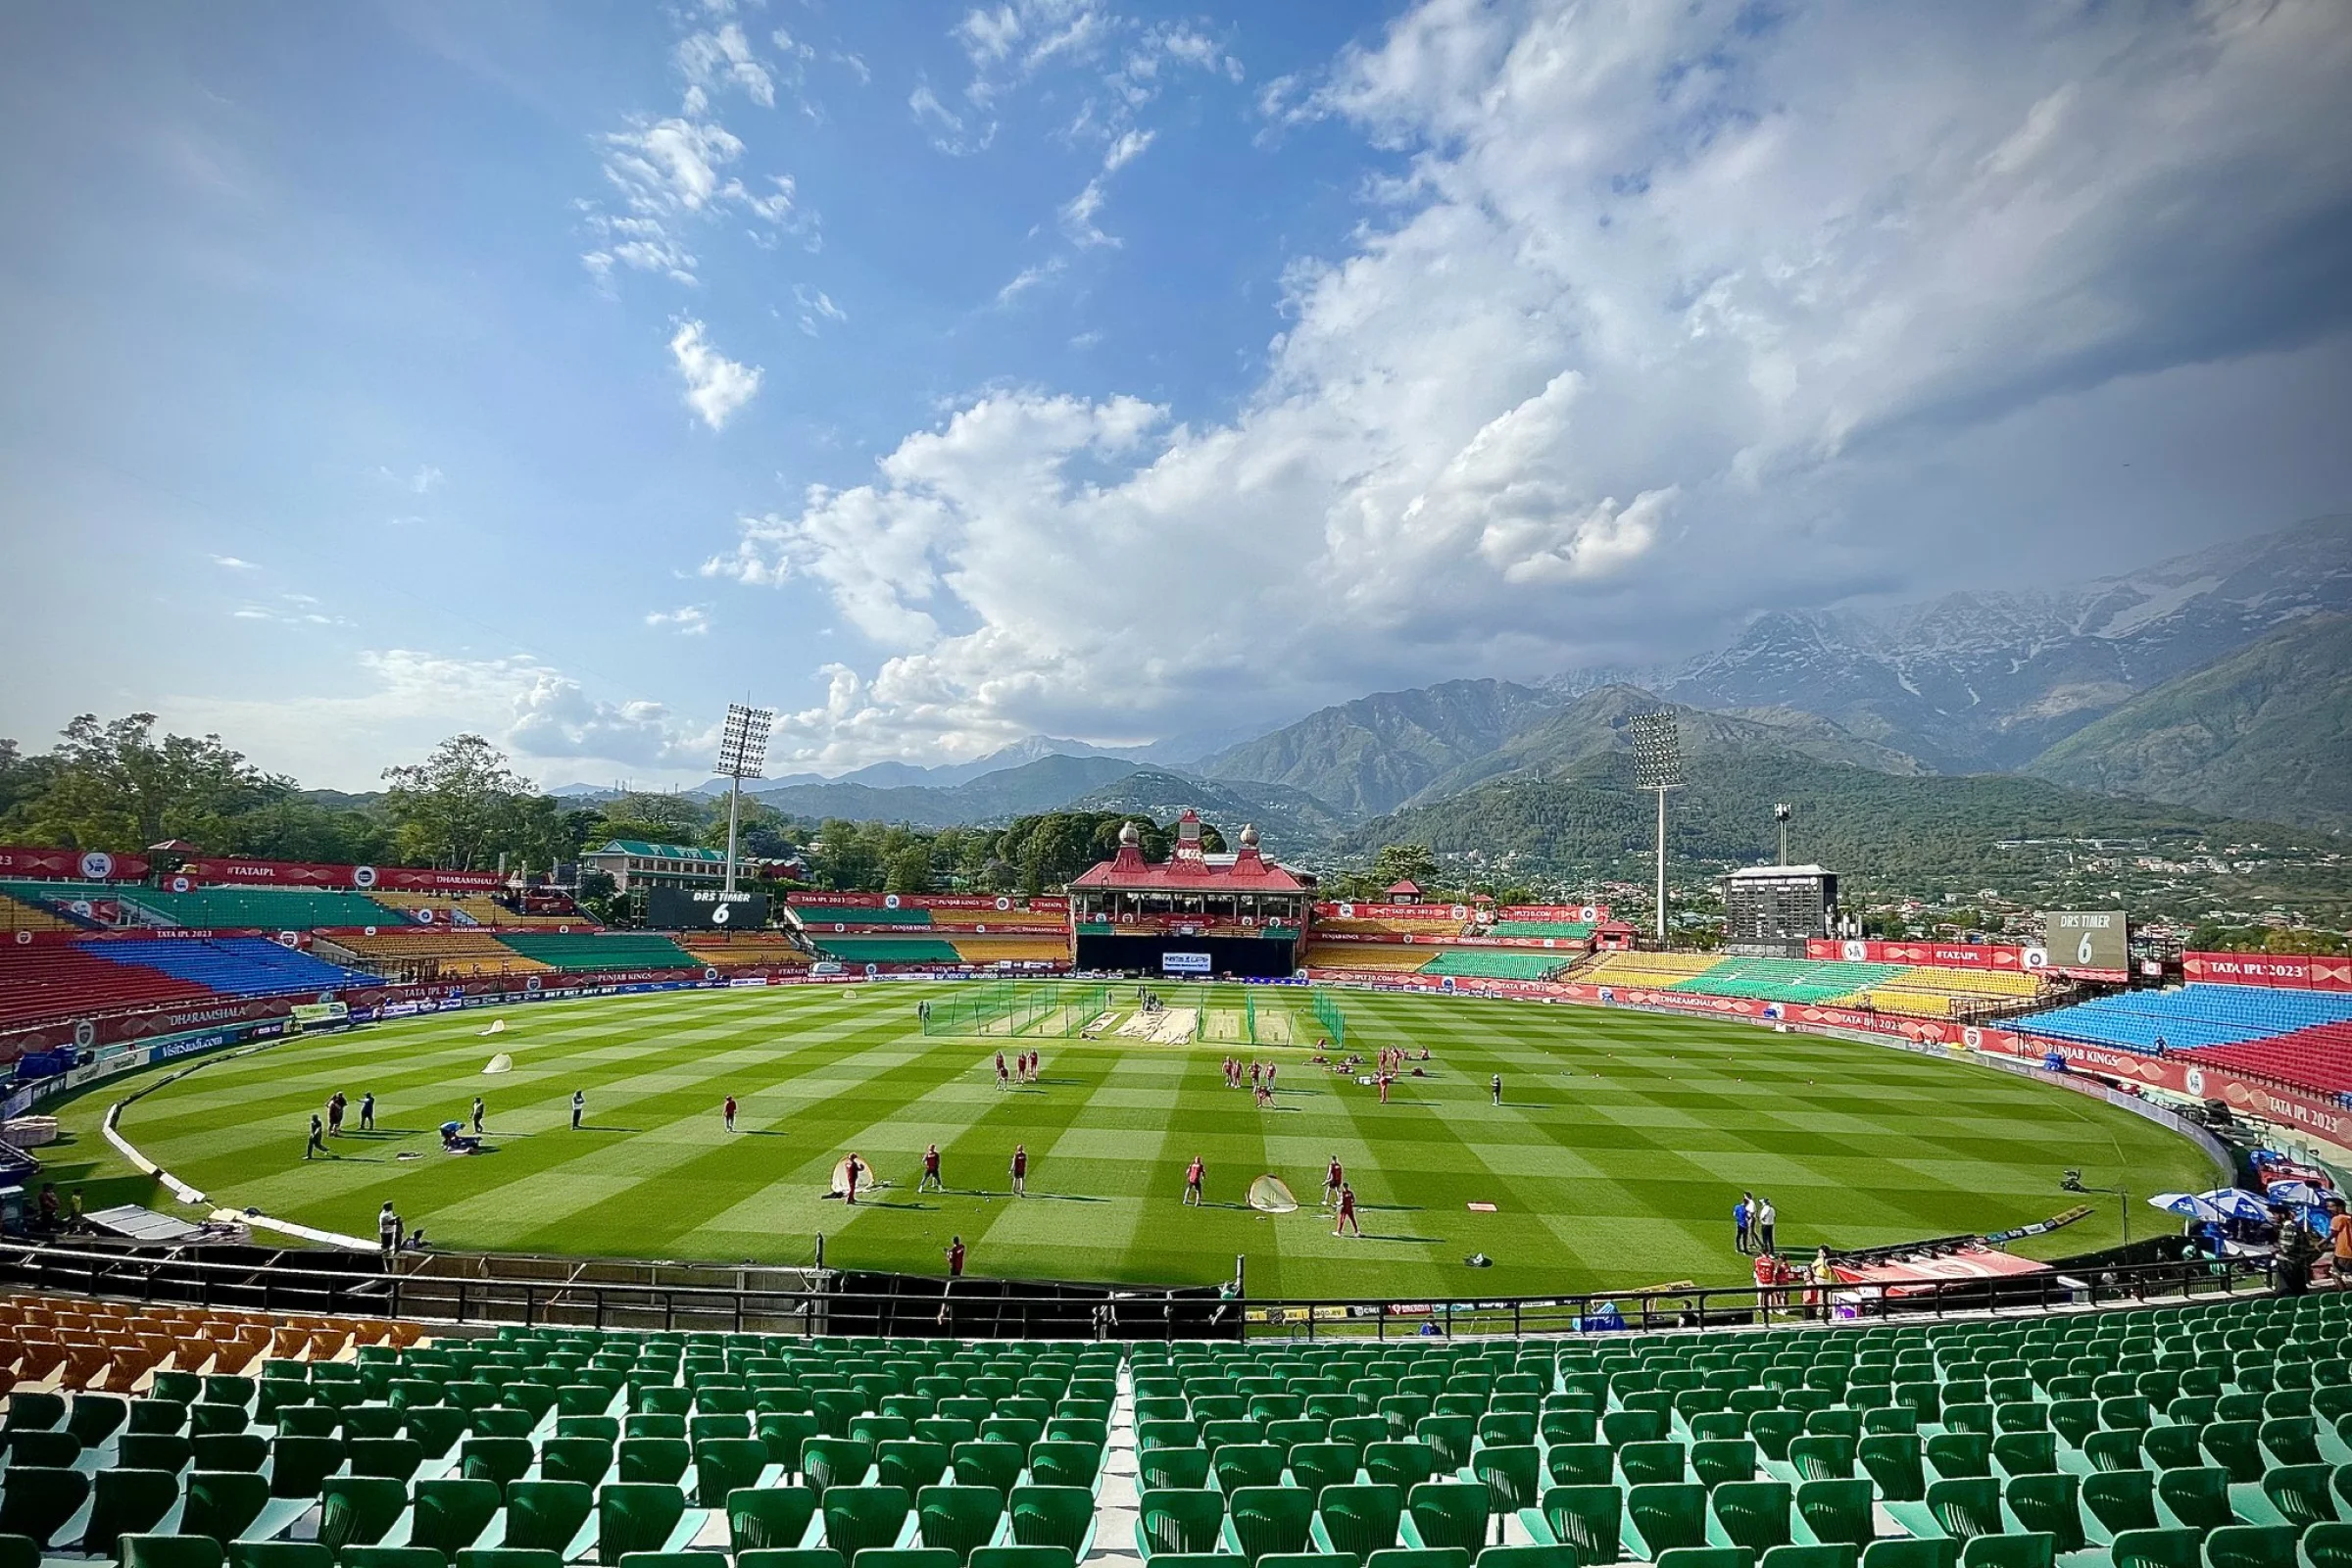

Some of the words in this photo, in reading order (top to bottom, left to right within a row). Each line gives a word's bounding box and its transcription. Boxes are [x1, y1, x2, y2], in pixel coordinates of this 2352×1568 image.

[226, 866, 275, 877] #TATAIPL
[693, 892, 716, 902] DRS
[718, 893, 751, 903] TIMER
[711, 903, 730, 924] 6
[2060, 914, 2079, 928] DRS
[2082, 914, 2111, 929] TIMER
[2078, 932, 2092, 964] 6
[1936, 951, 1980, 961] #TATAIPL
[2211, 961, 2241, 974] TATA
[2243, 963, 2264, 975] IPL
[2269, 964, 2303, 978] 2023
[598, 973, 627, 983] PUNJAB
[627, 972, 653, 981] KINGS
[405, 988, 426, 998] TATA
[428, 987, 441, 997] IPL
[170, 1006, 247, 1026] DHARAMSHALA
[1841, 1014, 1861, 1024] TATA
[2047, 1043, 2084, 1060] PUNJAB
[2086, 1049, 2118, 1066] KINGS
[2269, 1096, 2292, 1117] TATA
[2294, 1104, 2310, 1124] IPL
[2311, 1109, 2337, 1133] 2023
